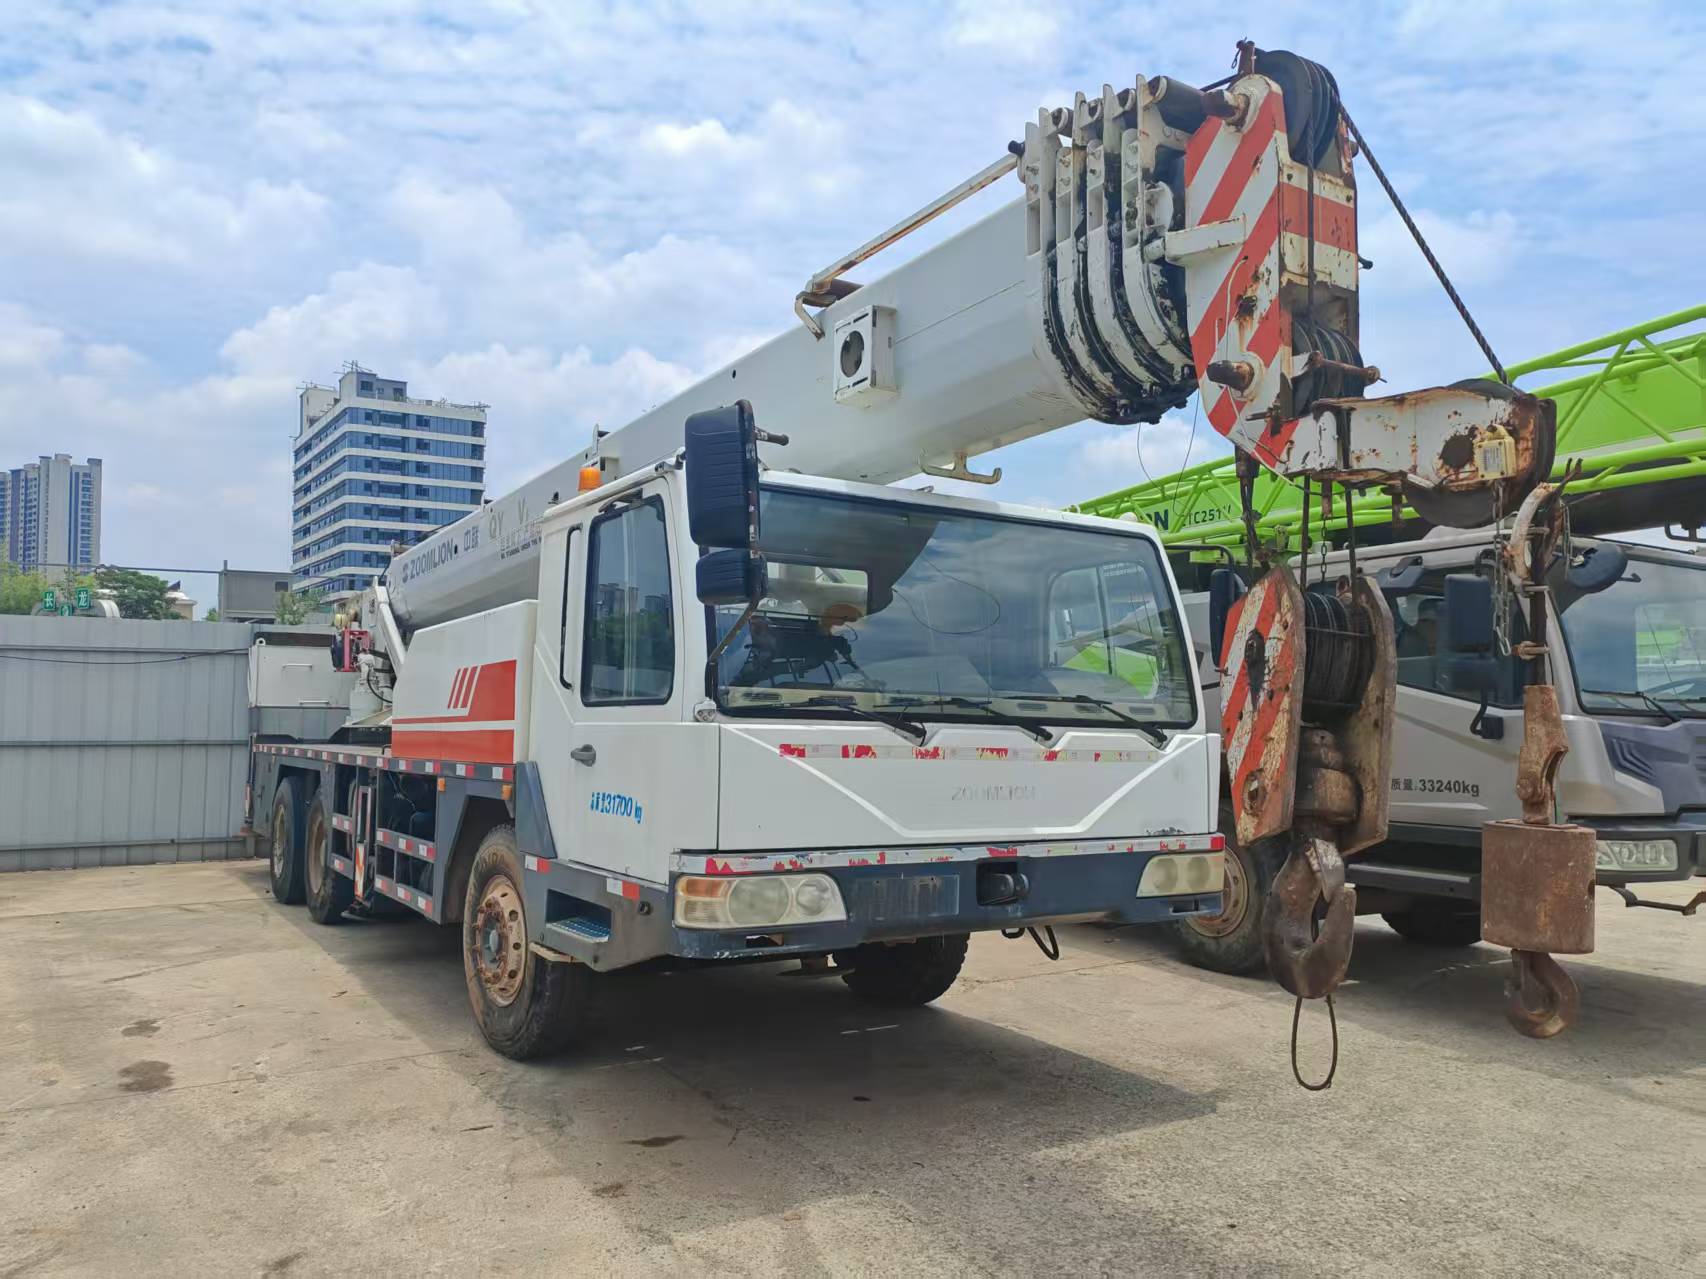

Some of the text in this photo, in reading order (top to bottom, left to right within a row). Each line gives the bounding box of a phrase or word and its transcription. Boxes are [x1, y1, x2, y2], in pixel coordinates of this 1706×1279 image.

[1140, 509, 1168, 530] N
[1183, 504, 1231, 527] TC251V
[410, 538, 453, 580] ZOOMLION
